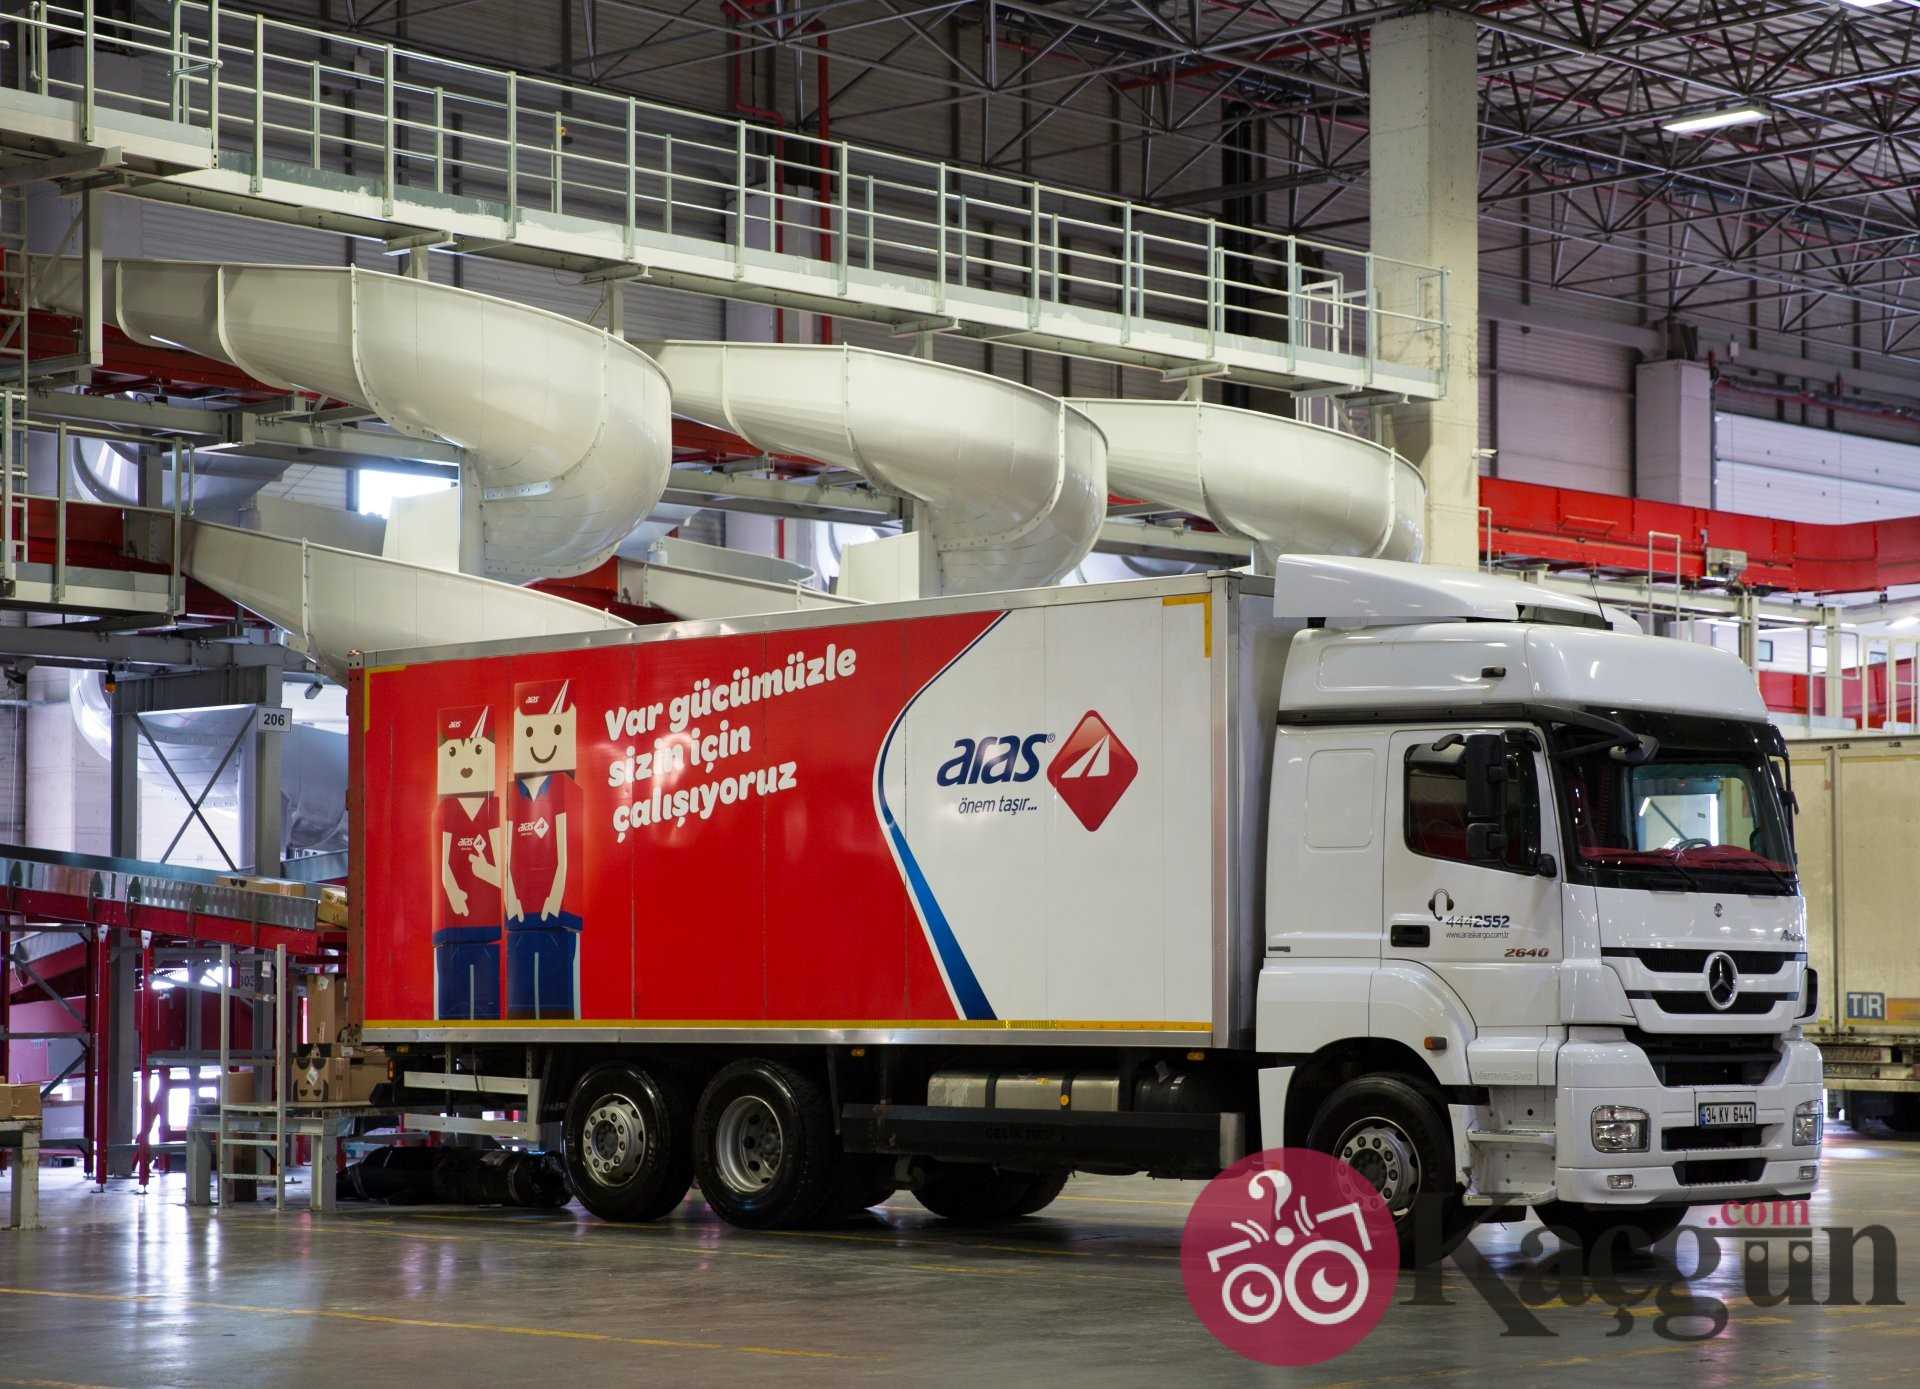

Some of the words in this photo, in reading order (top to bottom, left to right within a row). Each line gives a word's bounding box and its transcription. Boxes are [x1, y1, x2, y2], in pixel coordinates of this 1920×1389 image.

[605, 703, 663, 741] Var
[669, 643, 857, 733] gücümüzle
[263, 713, 285, 726] 206
[607, 737, 685, 788] sizin
[690, 719, 751, 774] için
[612, 761, 797, 843] çalışıyoruz
[958, 797, 995, 814] önem
[998, 795, 1038, 815] taşır...
[1445, 915, 1510, 928] 4442552
[1504, 947, 1550, 958] 2640
[1848, 993, 1882, 1017] TIR
[1706, 1107, 1716, 1122] 34
[1733, 1106, 1753, 1122] 6441
